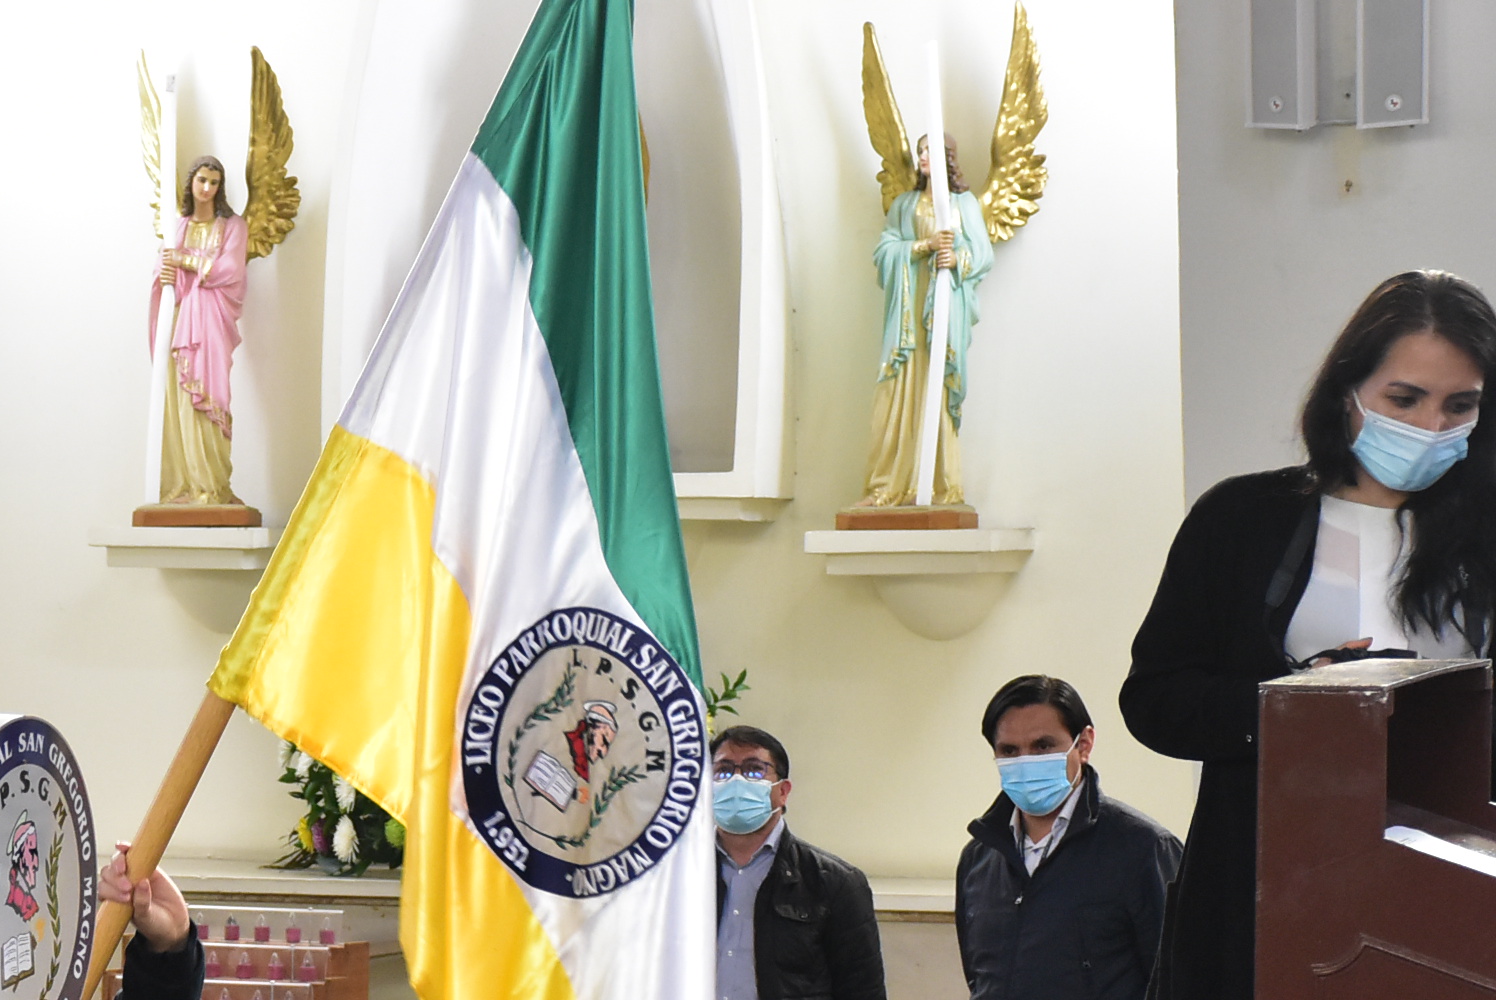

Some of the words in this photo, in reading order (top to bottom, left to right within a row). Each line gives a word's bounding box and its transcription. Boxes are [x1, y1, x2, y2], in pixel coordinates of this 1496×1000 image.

[492, 611, 635, 689] PARROQUIAL
[630, 642, 683, 702] SAN
[465, 684, 504, 767] LICEO
[645, 698, 701, 849] GREGORIO
[18, 732, 45, 754] SAN
[48, 743, 91, 861] GREGORIO
[73, 876, 93, 980] MAGNO
